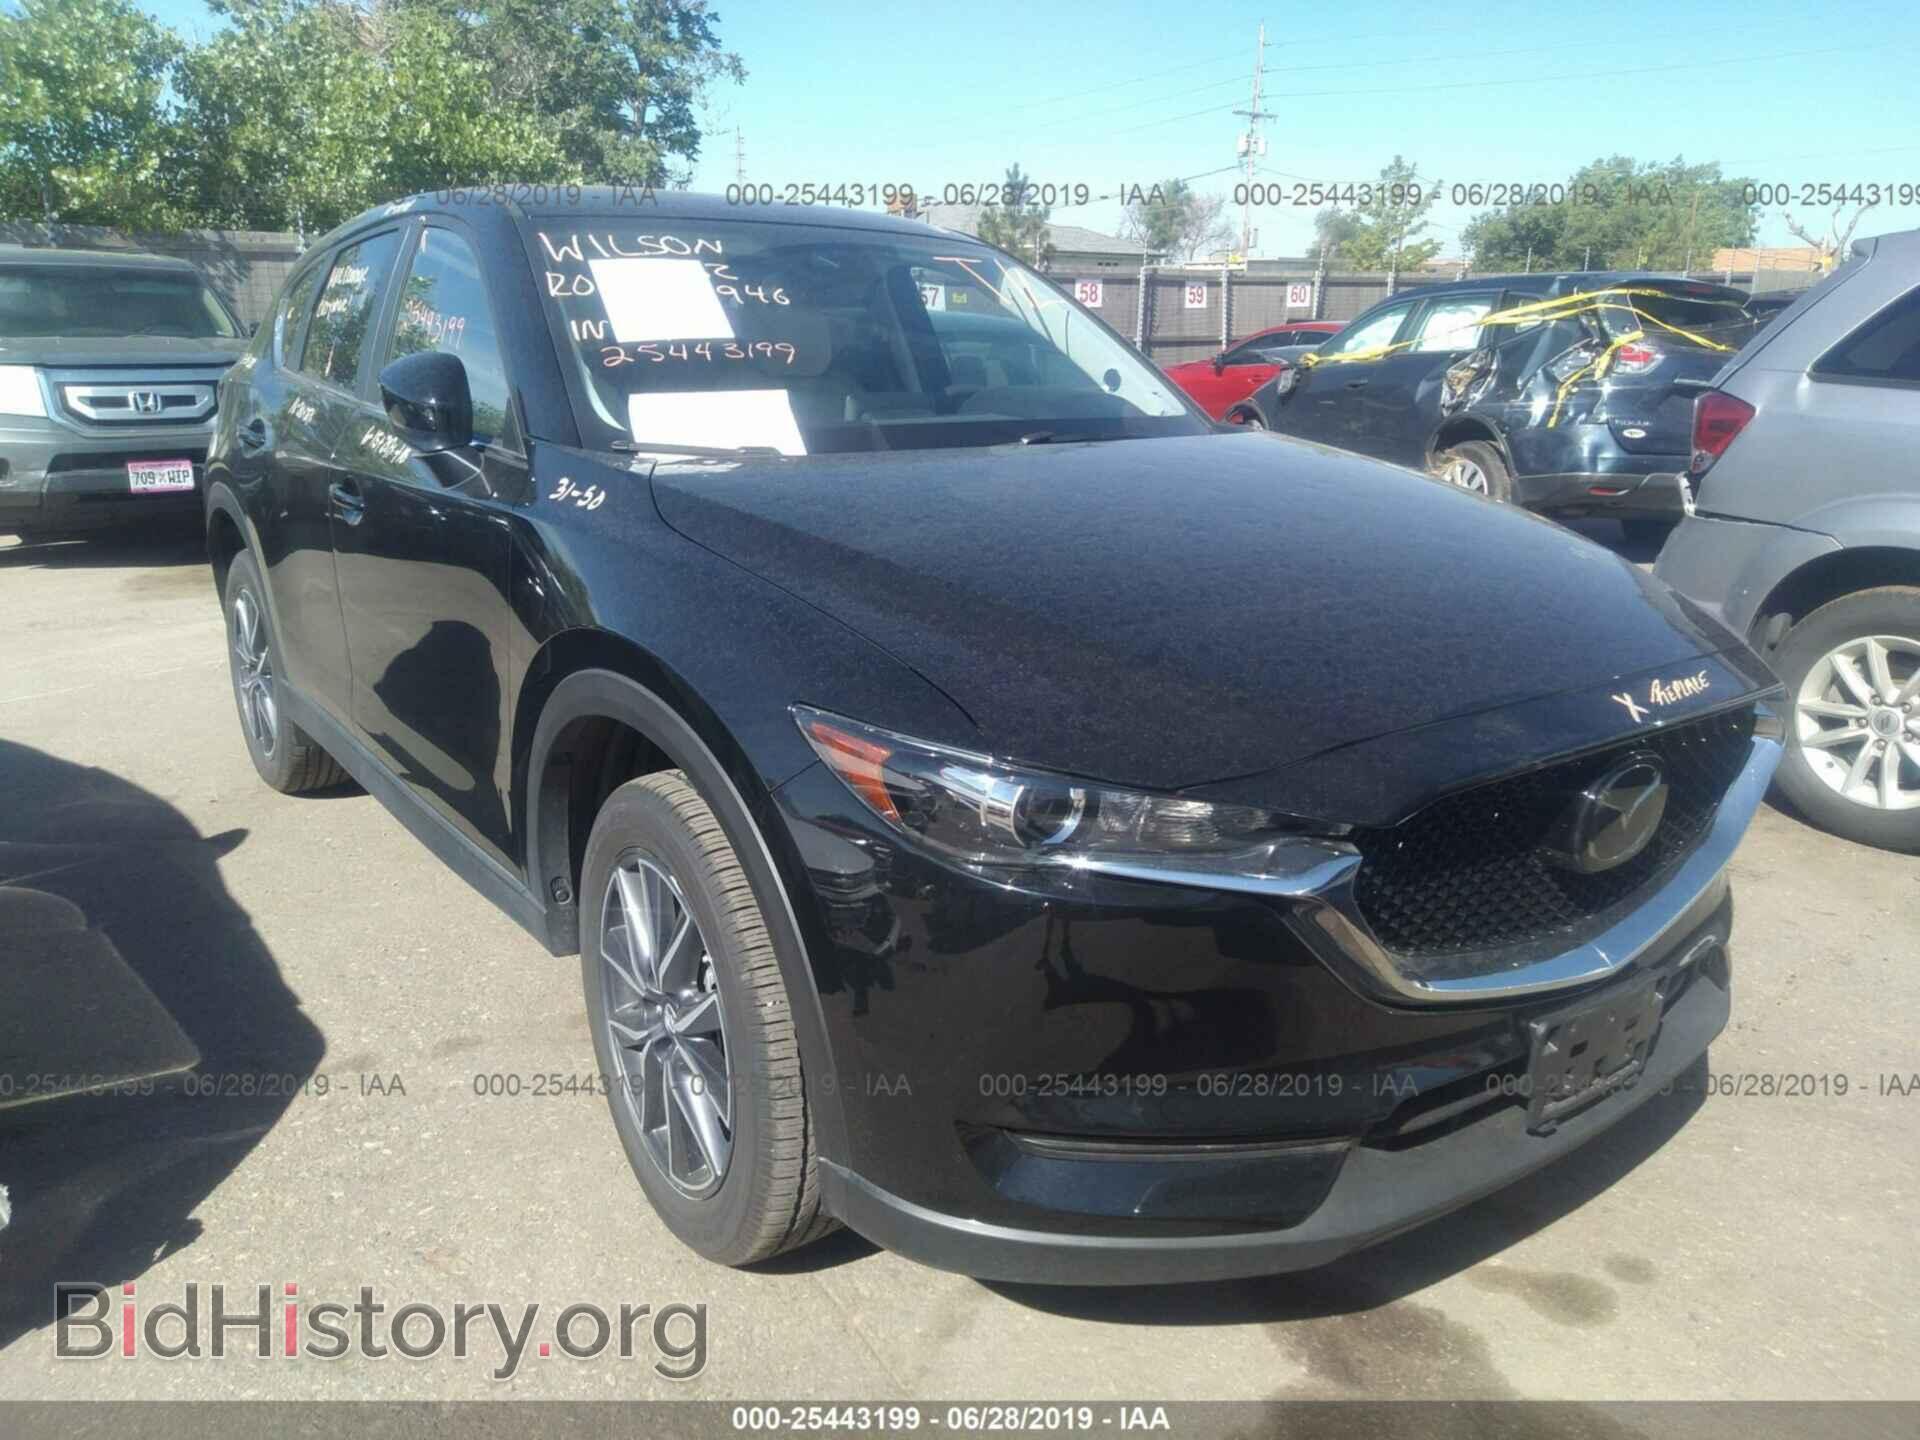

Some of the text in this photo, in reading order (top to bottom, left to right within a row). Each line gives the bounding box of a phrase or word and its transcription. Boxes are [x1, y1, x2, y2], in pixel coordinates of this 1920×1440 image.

[538, 232, 723, 262] WILSON
[1079, 283, 1099, 303] 58
[1188, 288, 1204, 305] 59
[1290, 286, 1307, 304] 60
[601, 342, 797, 367] 25443199
